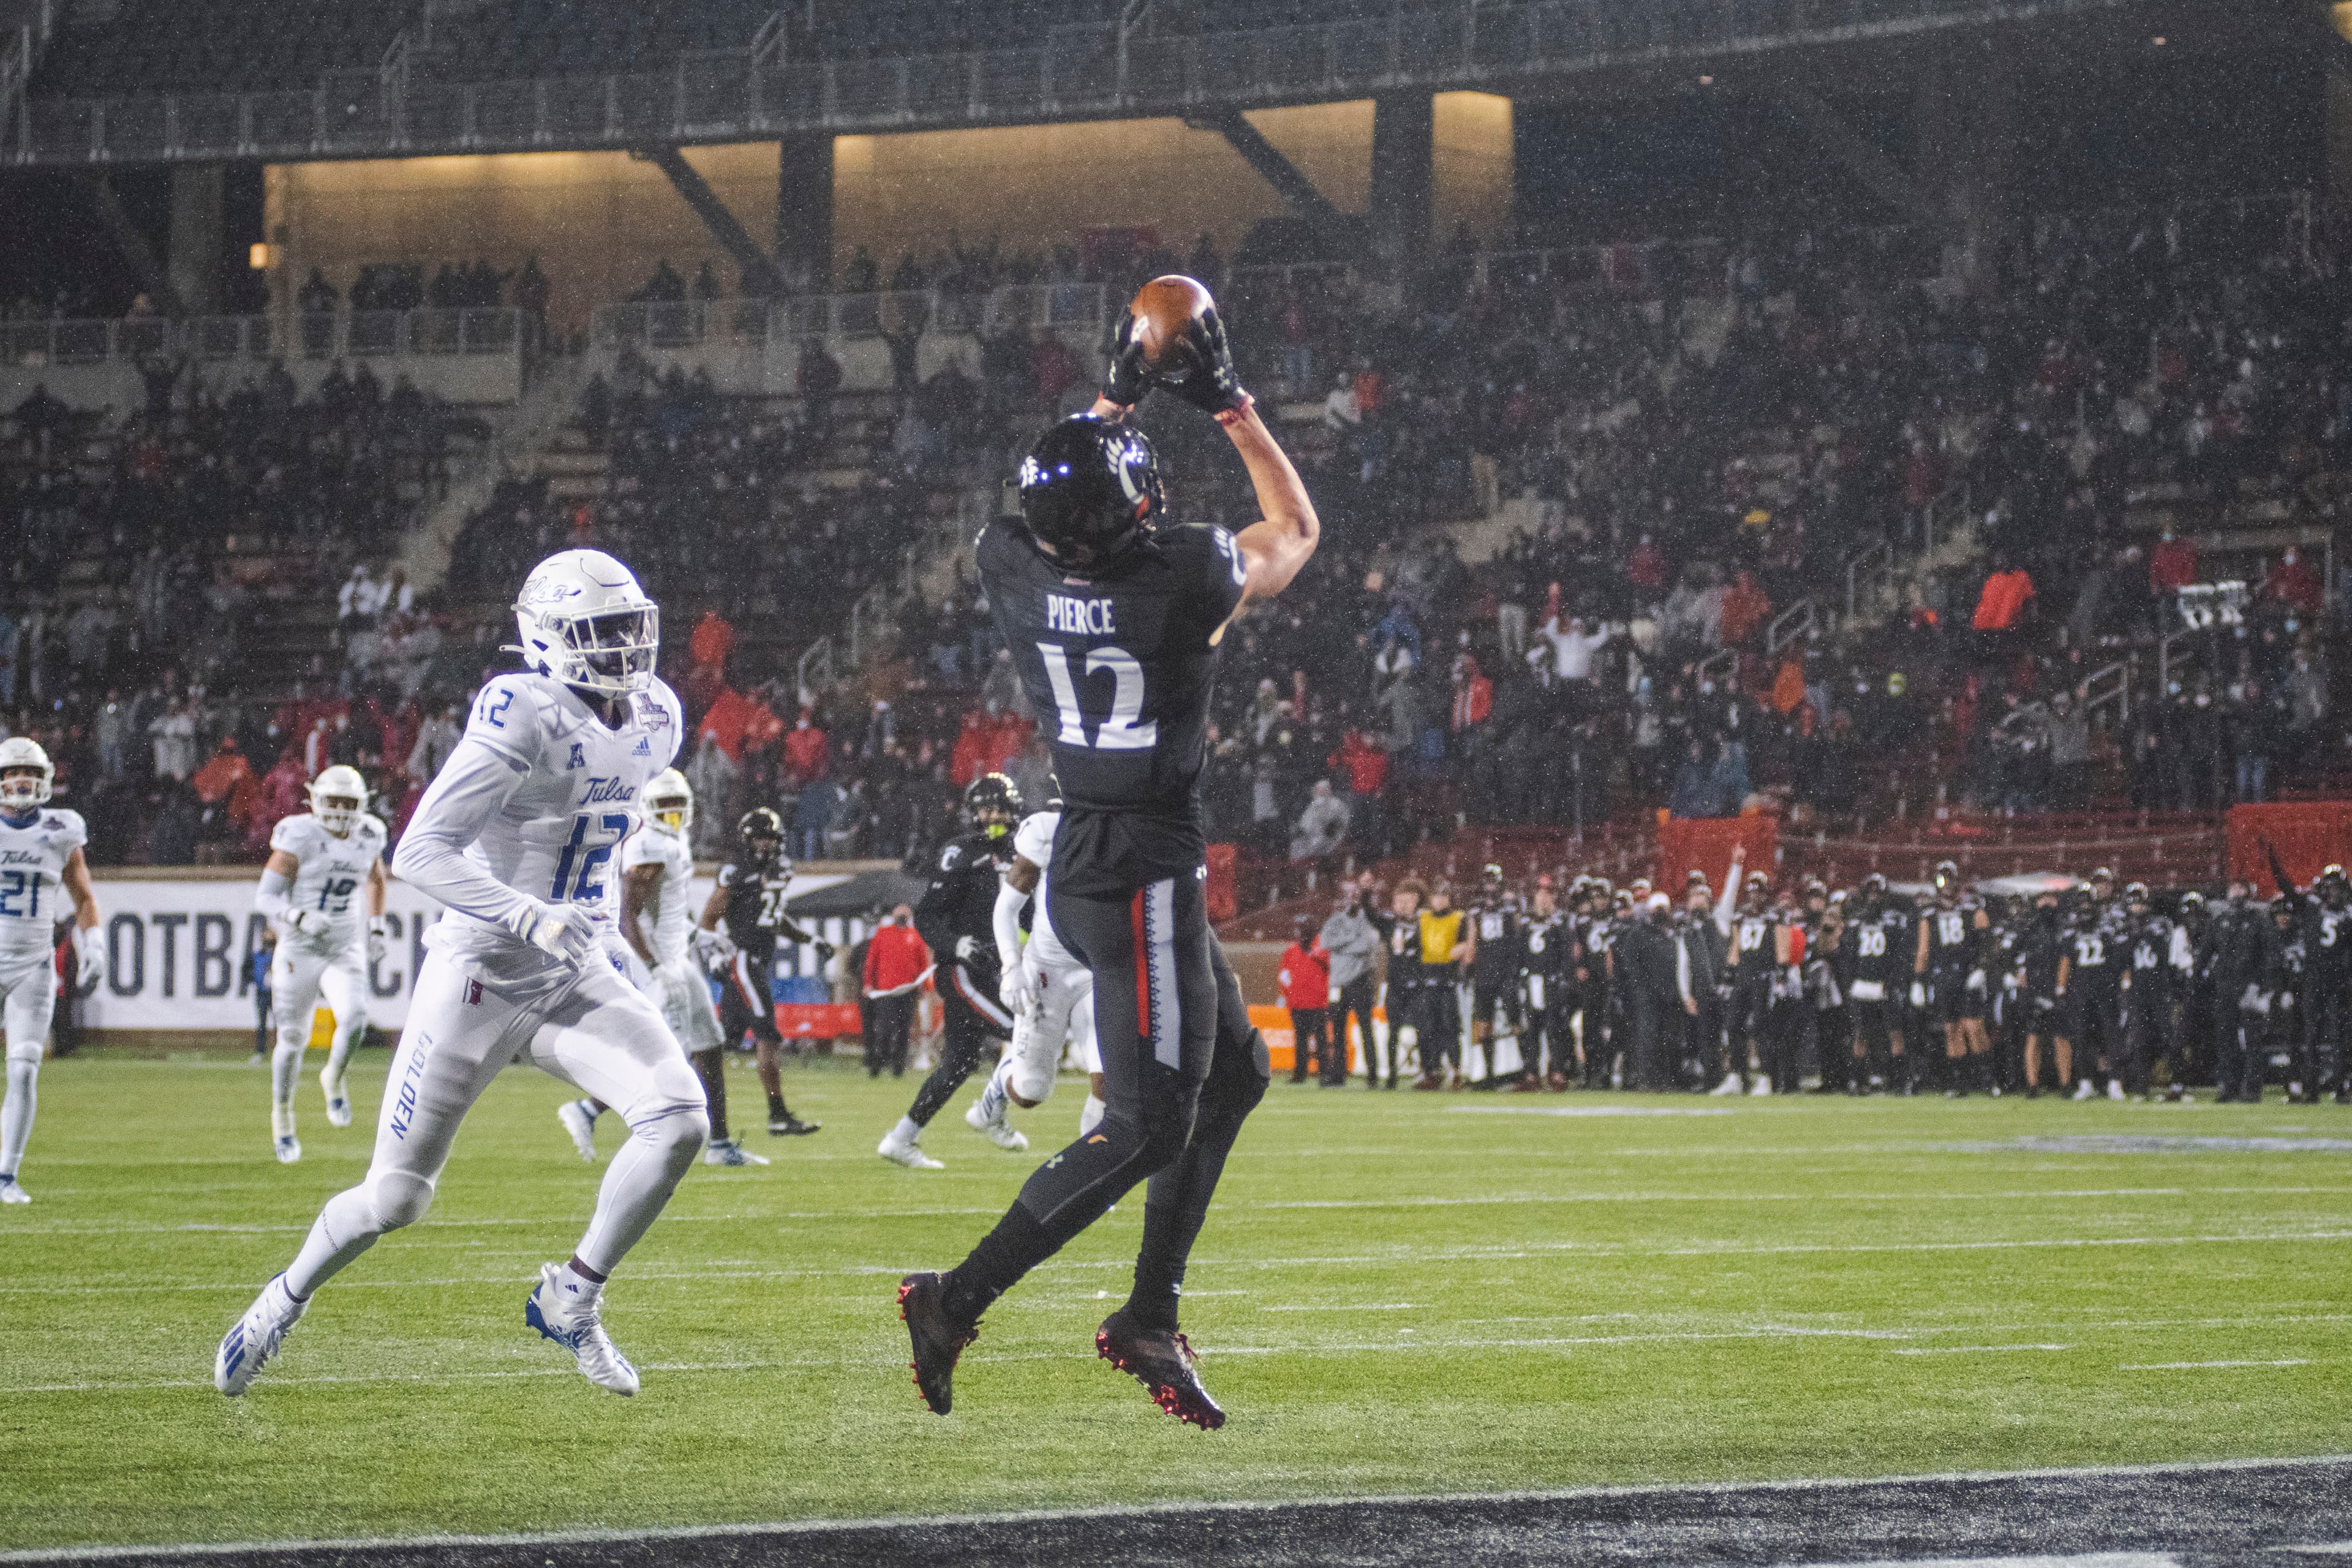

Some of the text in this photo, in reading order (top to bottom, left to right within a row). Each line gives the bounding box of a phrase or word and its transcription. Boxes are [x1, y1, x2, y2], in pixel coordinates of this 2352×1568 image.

[1047, 594, 1115, 635] PIERCE
[480, 687, 514, 728] 12
[1036, 642, 1158, 748] 12
[579, 776, 635, 805] Tulsa
[551, 814, 629, 900] 12
[0, 870, 41, 918] 21
[318, 878, 357, 911] 19
[2320, 917, 2338, 947] 5
[391, 1030, 432, 1140] GOLDEN
